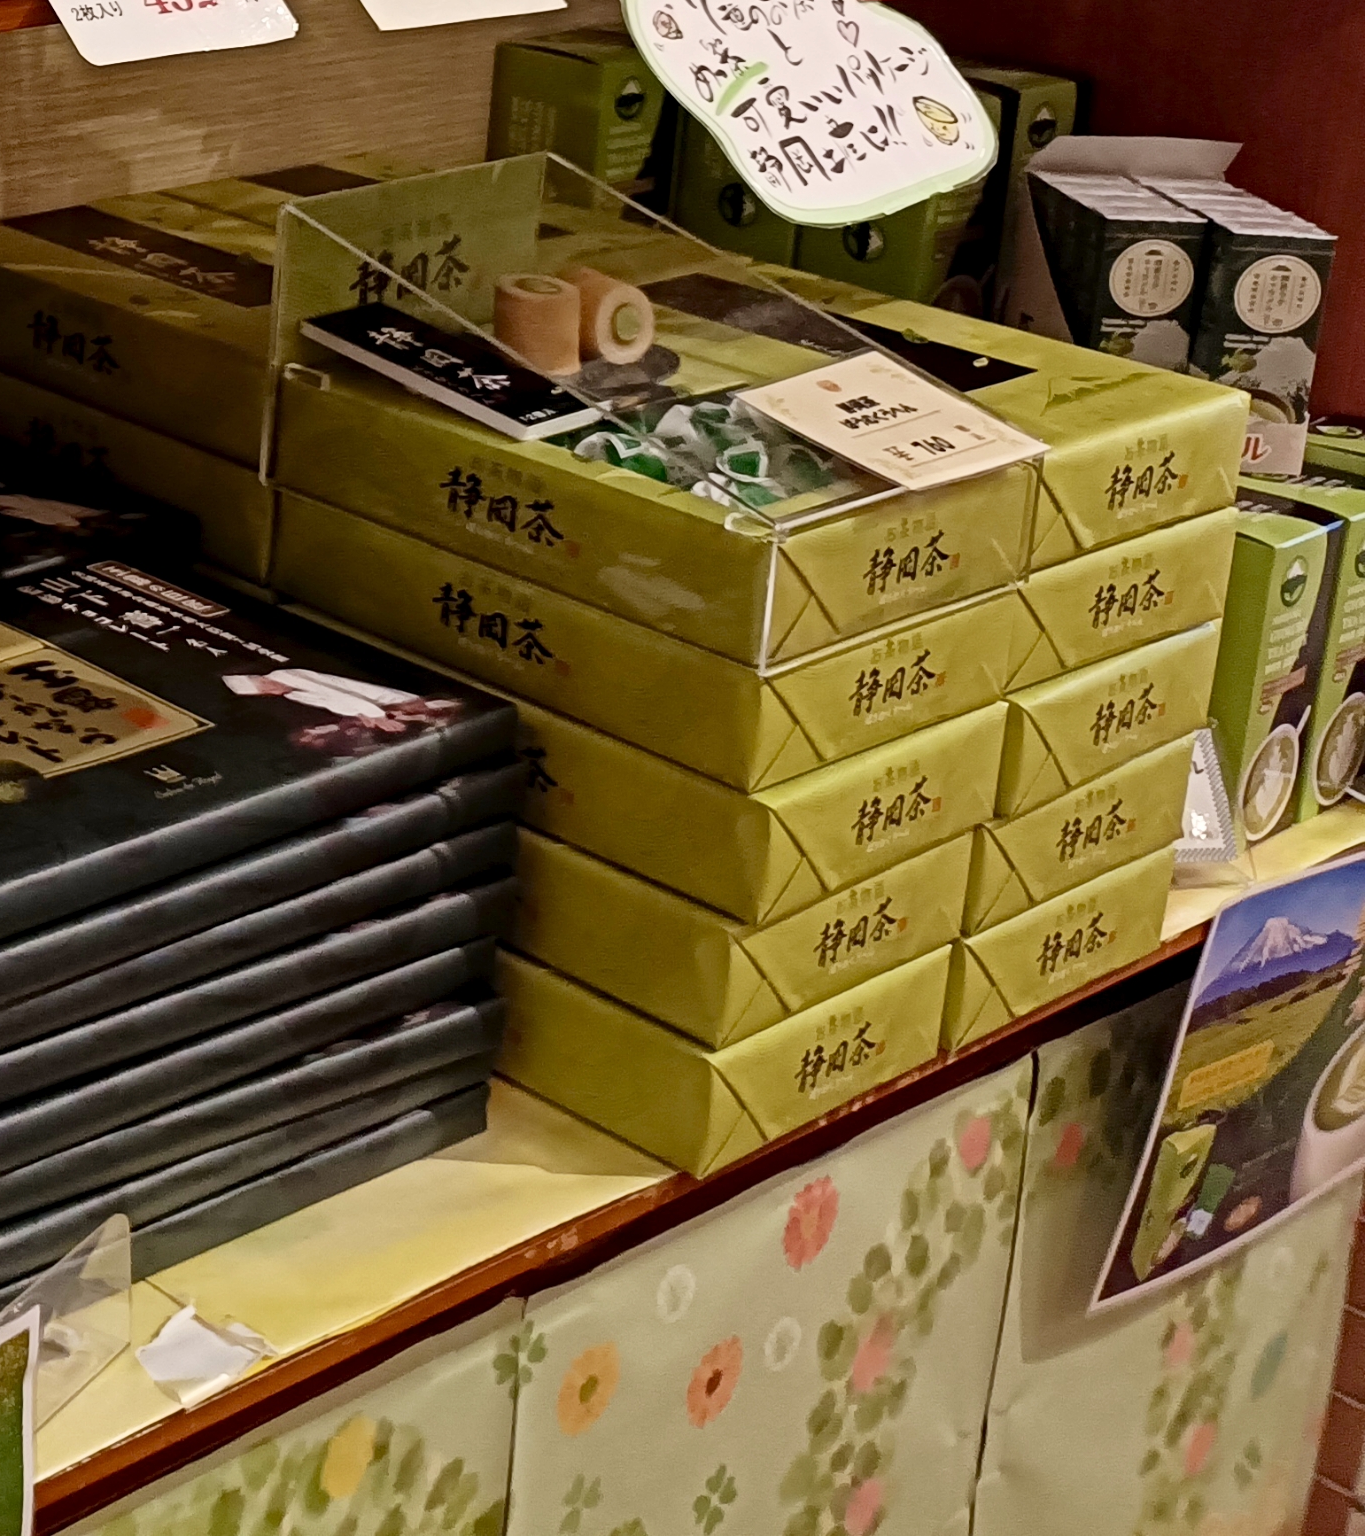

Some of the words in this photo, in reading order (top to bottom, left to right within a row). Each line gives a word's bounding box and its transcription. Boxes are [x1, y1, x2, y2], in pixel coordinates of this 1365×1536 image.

[71, 0, 123, 22] 2枚入り
[439, 466, 564, 547] 静岡茶
[1104, 450, 1181, 511] 静岡茶
[863, 530, 950, 595] 静岡茶
[432, 583, 556, 665] 静岡茶
[1087, 570, 1165, 630] 静岡茶
[848, 648, 937, 717] 静岡茶
[1087, 683, 1159, 747] 静岡茶
[522, 747, 559, 793] 茶
[850, 776, 931, 849] 静岡茶
[1055, 798, 1127, 864] 静岡茶
[813, 898, 898, 969] 静岡茶
[1036, 912, 1108, 976] 静岡茶
[794, 1021, 877, 1092] 静岡茶
